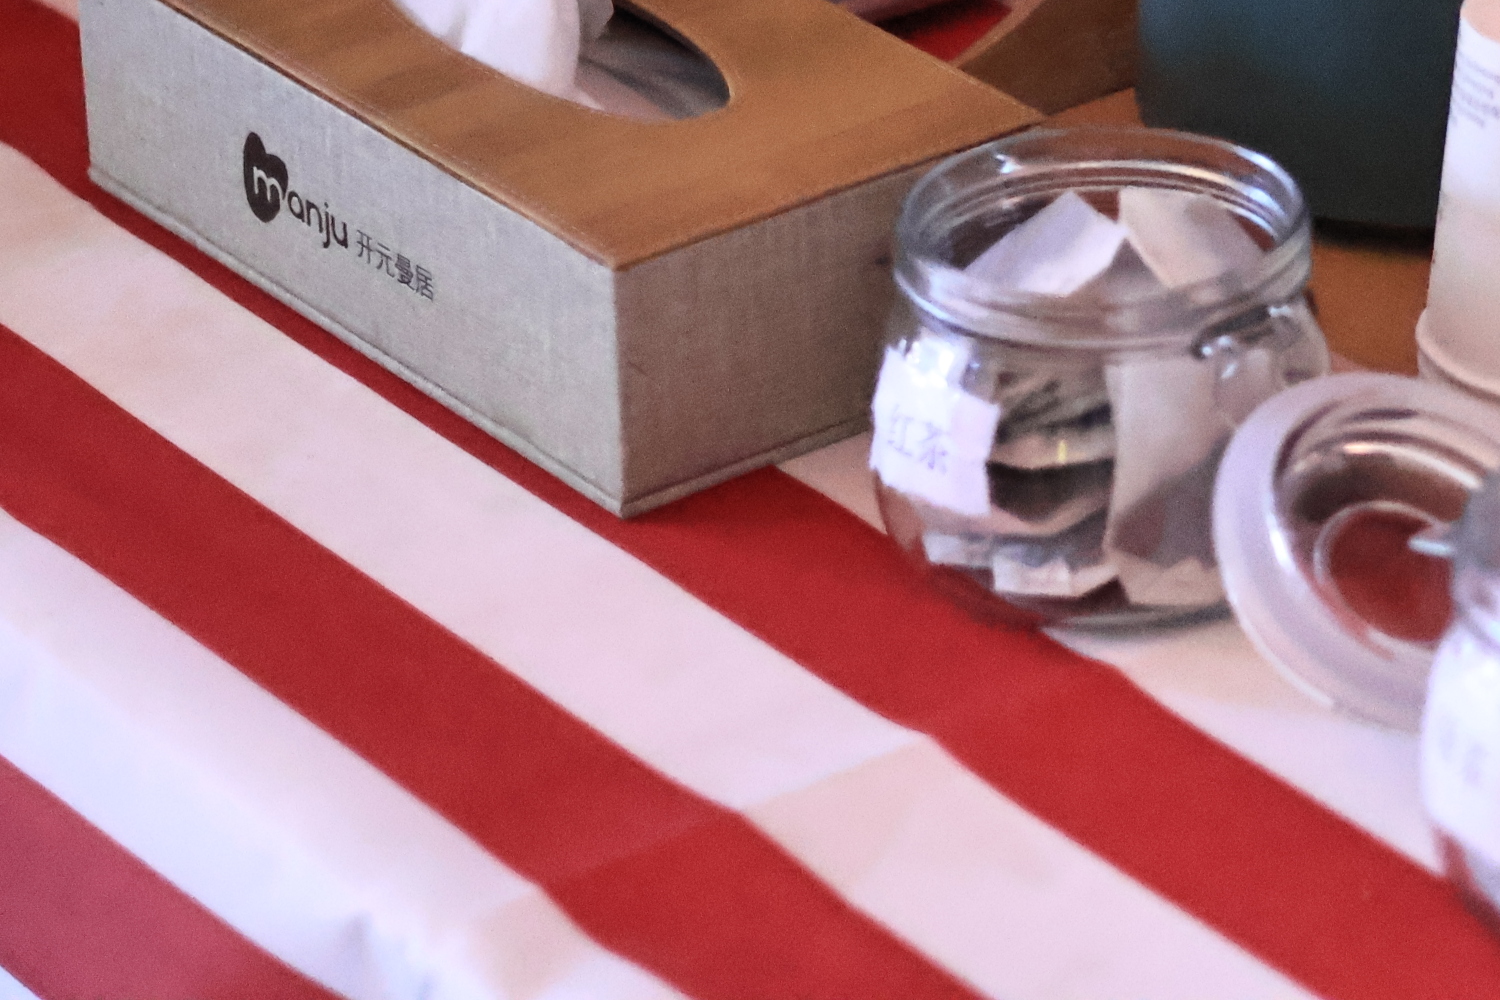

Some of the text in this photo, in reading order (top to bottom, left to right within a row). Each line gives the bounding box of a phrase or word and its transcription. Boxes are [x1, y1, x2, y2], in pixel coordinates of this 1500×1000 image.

[252, 166, 434, 301] manju 开元曼居
